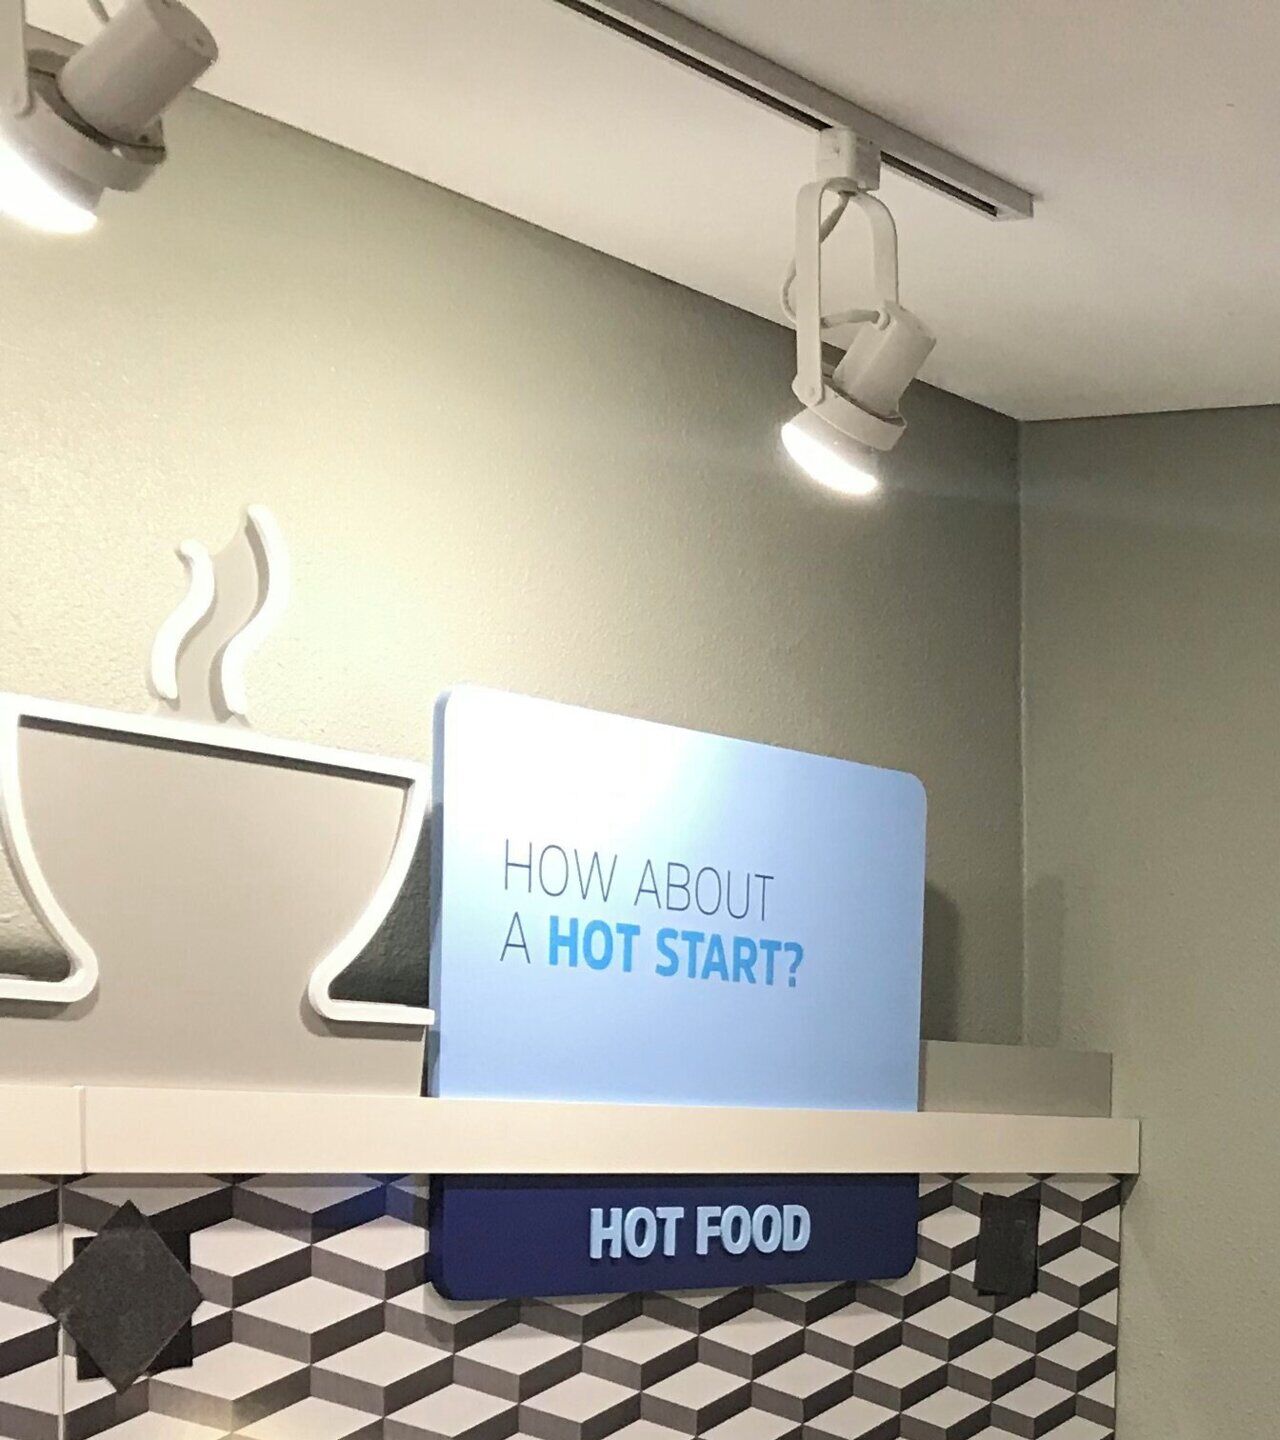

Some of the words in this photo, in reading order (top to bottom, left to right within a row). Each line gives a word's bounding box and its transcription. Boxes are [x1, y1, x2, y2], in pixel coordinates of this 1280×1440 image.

[503, 837, 618, 903] HOW
[633, 857, 776, 923] ABOUT
[500, 911, 532, 966] A
[548, 916, 642, 973] HOT
[655, 928, 805, 989] START?
[589, 1206, 687, 1260] HOT
[696, 1203, 812, 1256] FOOD
